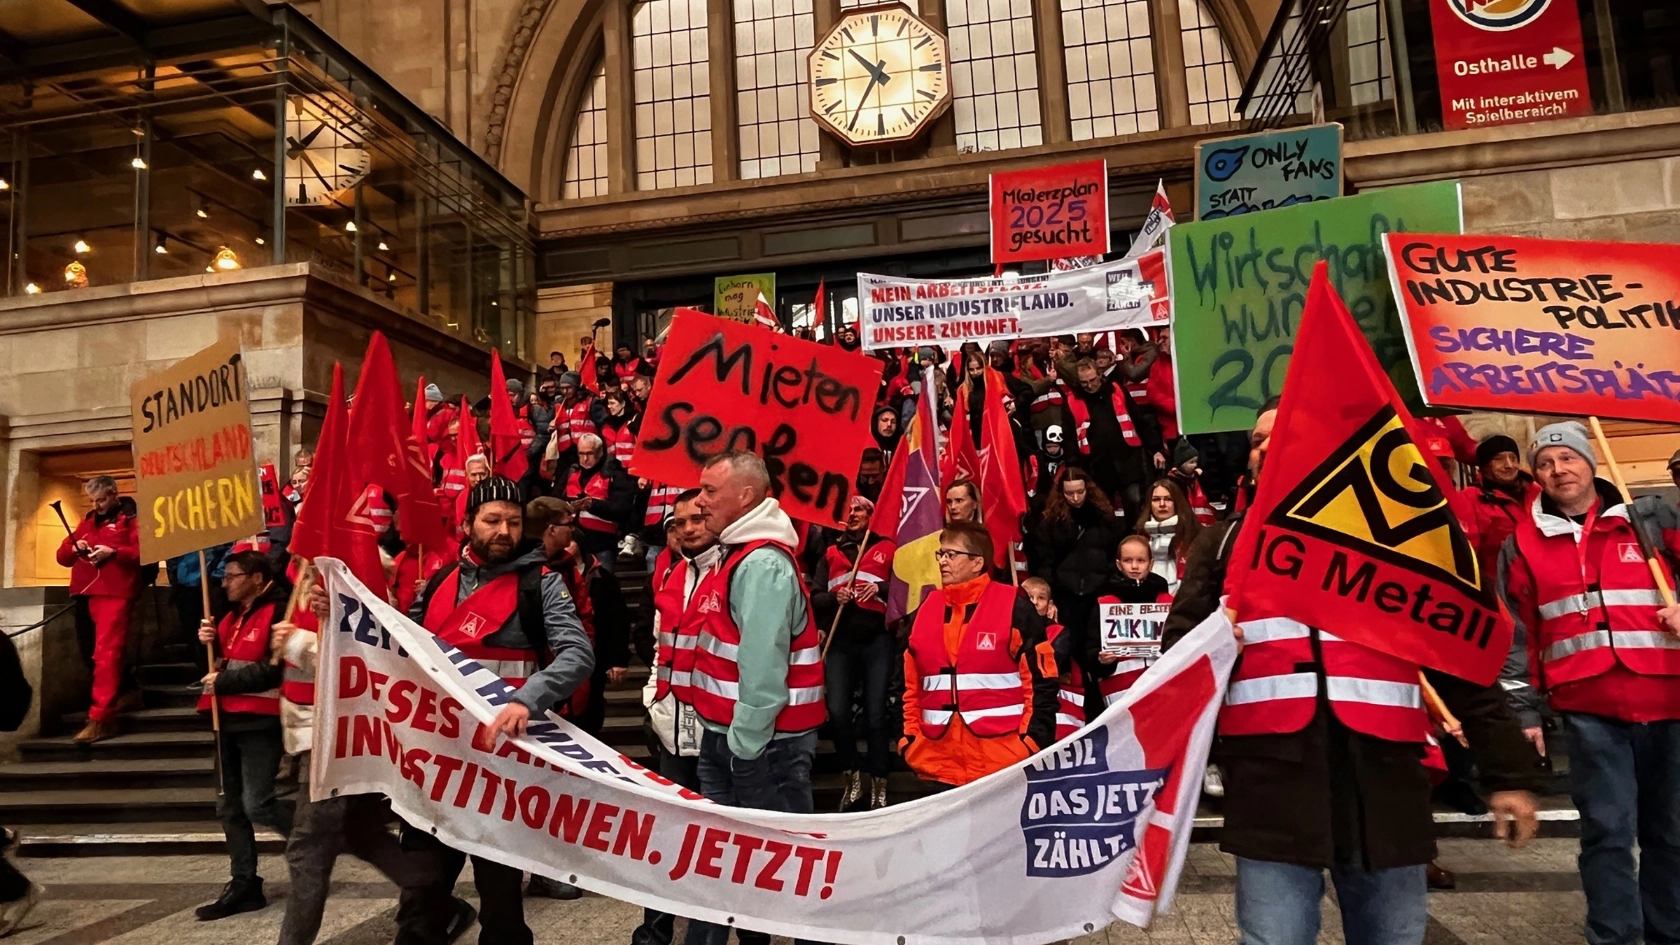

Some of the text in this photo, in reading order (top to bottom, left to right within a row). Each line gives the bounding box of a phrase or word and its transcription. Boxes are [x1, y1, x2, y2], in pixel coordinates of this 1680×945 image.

[1454, 54, 1538, 76] Osthalle
[1452, 88, 1579, 111] Mit interaktivem
[1465, 102, 1567, 124] Spielbereich!
[1251, 138, 1309, 168] ONLY
[1281, 158, 1335, 181] FANS
[1003, 178, 1099, 209] M(a)erzplan
[1209, 187, 1257, 209] STATT
[1010, 200, 1087, 229] 2025
[1008, 220, 1093, 252] gesucht
[1402, 242, 1517, 274] GUTE
[724, 292, 744, 303] mag
[871, 285, 911, 303] MEIN
[872, 305, 924, 322] UNSER
[873, 318, 1023, 343] UNSERE ZUKUNFT.
[1429, 325, 1595, 360] SICHERE
[667, 332, 862, 422] Mieten
[141, 353, 241, 433] STANDORT
[153, 470, 255, 538] SICHERN
[1251, 530, 1497, 650] IG Metall
[1109, 605, 1133, 615] EINE
[1105, 618, 1164, 640] ZUKUN
[1032, 738, 1096, 772] WEIL
[1028, 777, 1164, 821] DAS JETZ
[669, 823, 843, 900] JETZT!
[1033, 831, 1128, 869] ZÄHLT.
